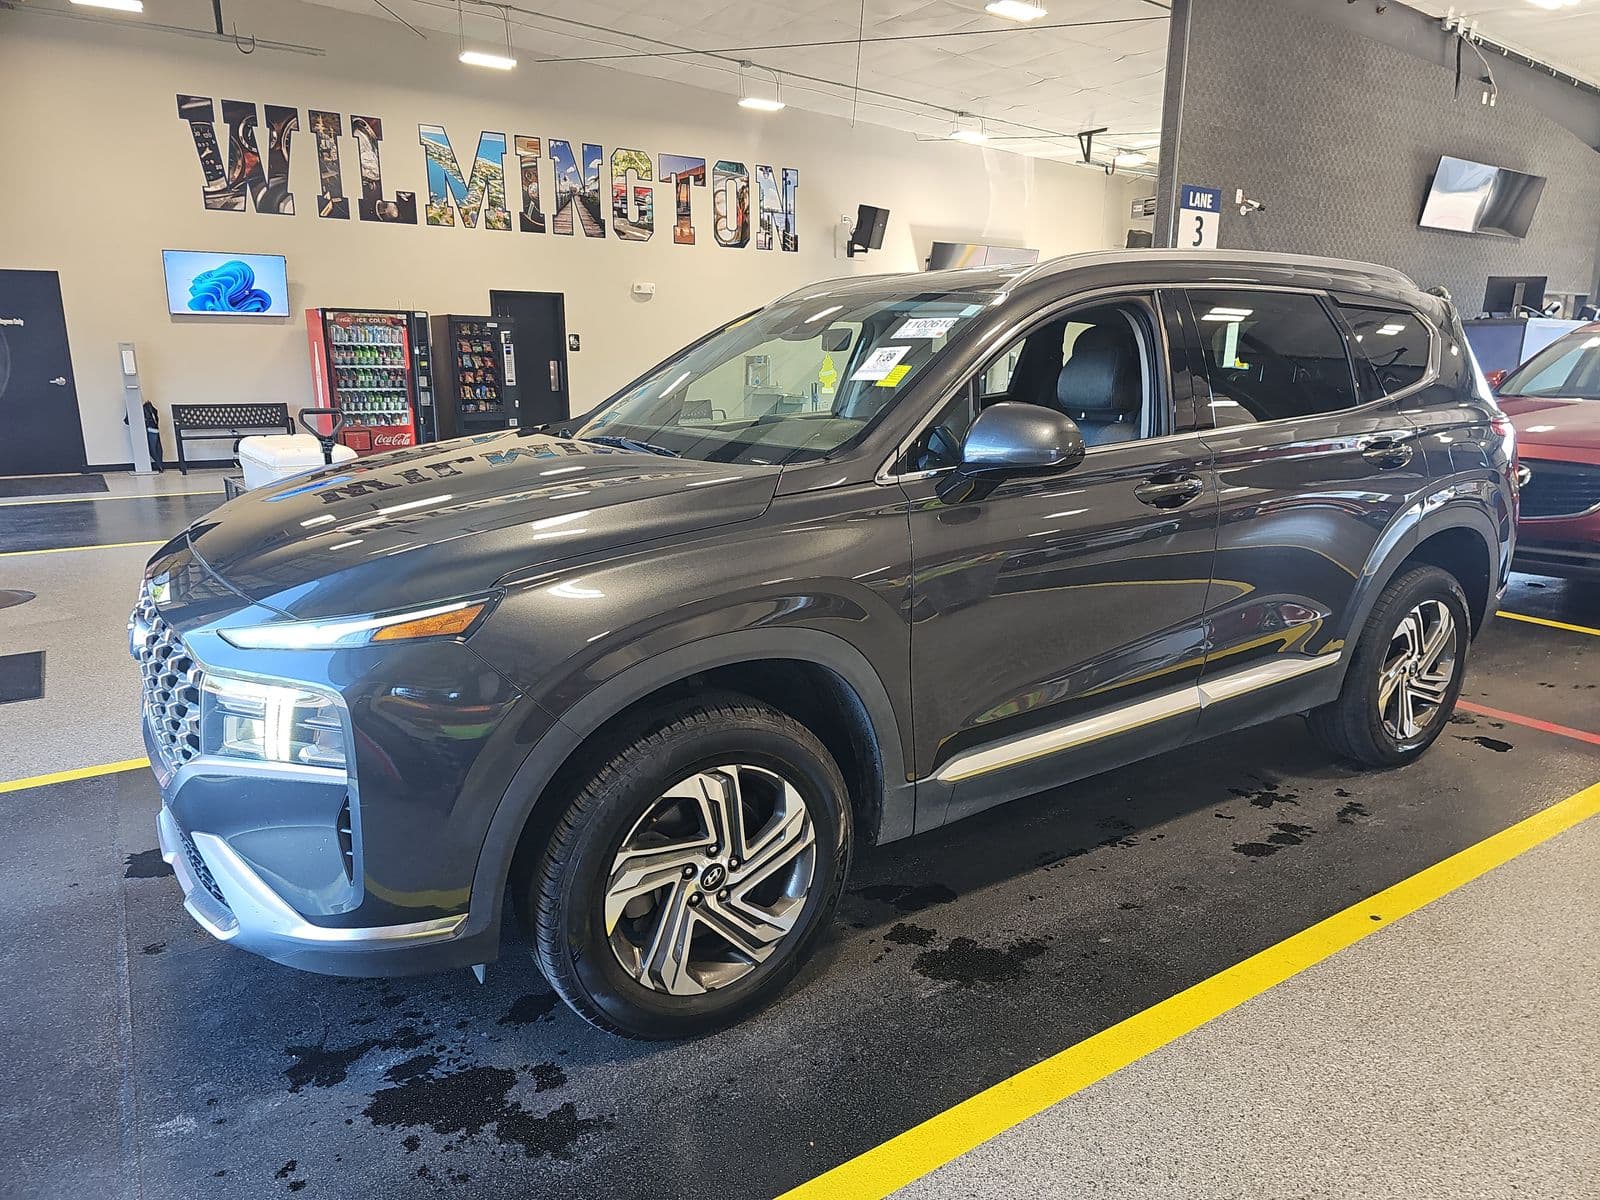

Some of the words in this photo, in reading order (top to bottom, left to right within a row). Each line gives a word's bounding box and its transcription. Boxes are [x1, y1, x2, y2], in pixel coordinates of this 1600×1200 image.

[177, 94, 798, 252] WILMINGTON
[1189, 191, 1213, 209] LANE
[1192, 215, 1204, 247] 3
